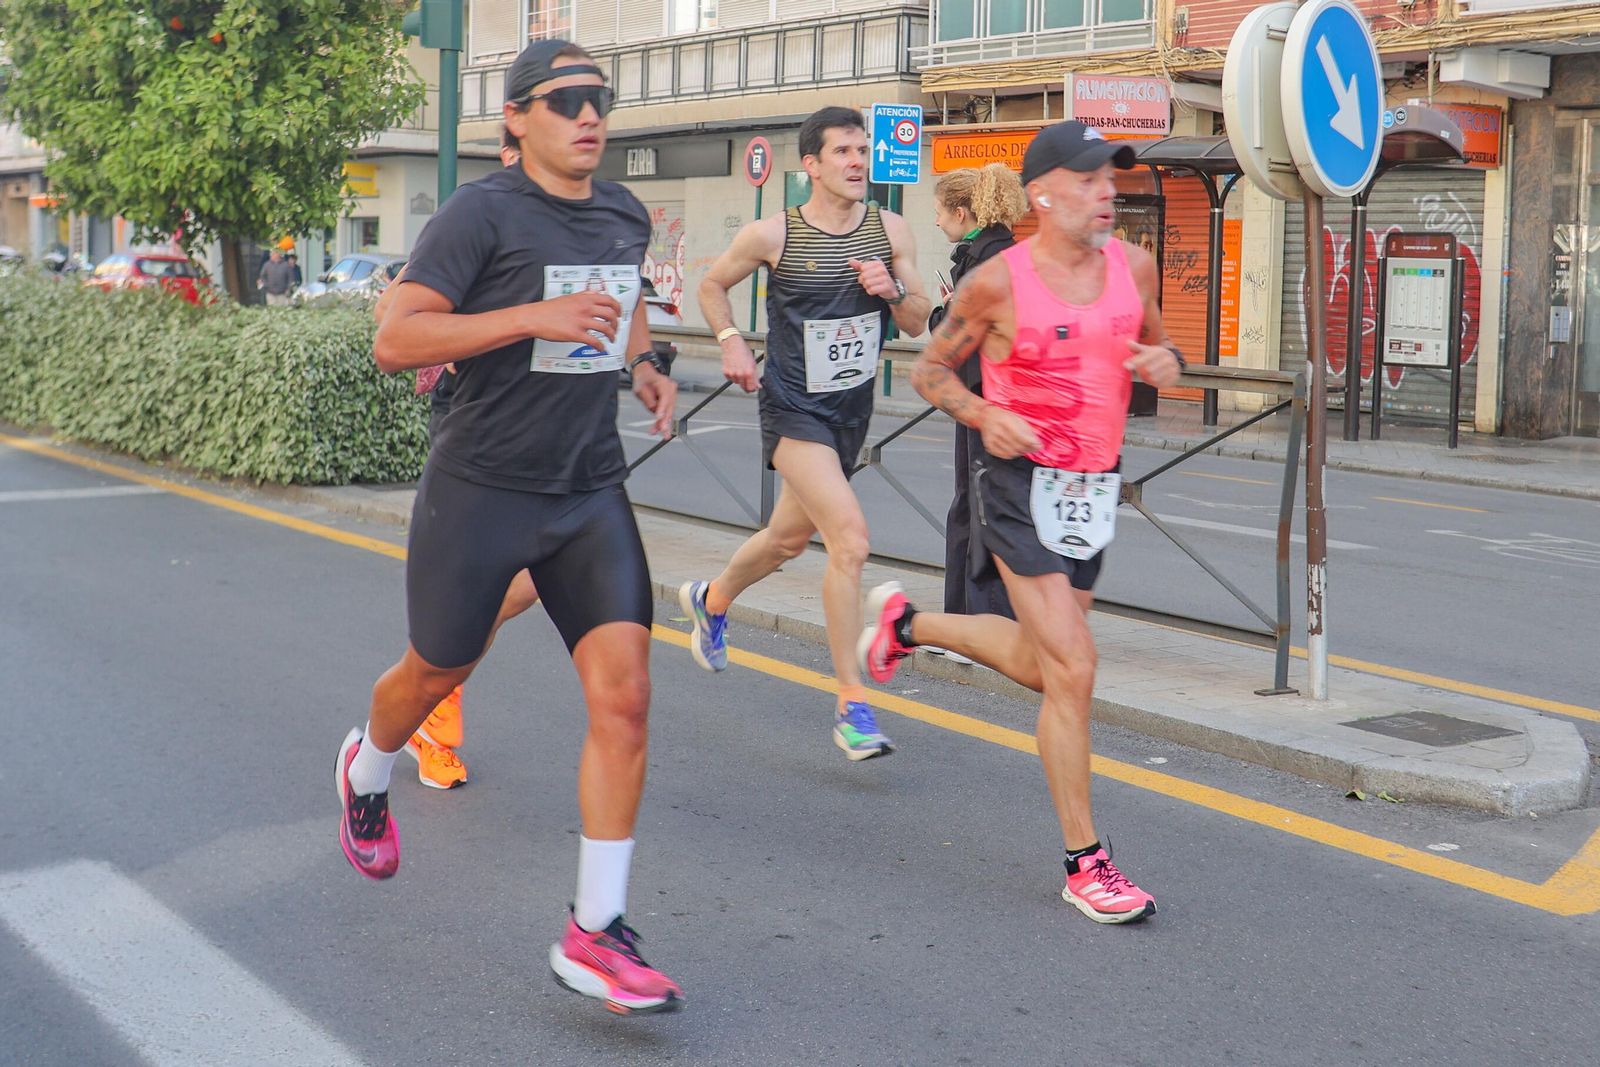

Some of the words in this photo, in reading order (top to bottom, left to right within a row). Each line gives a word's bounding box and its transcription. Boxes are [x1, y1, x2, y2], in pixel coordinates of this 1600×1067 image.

[876, 107, 919, 117] ATENCIÓN
[899, 127, 913, 137] 30
[943, 143, 1008, 159] ARREGLOS
[626, 148, 656, 176] EZRA
[828, 340, 864, 361] 872
[1054, 499, 1092, 522] 123
